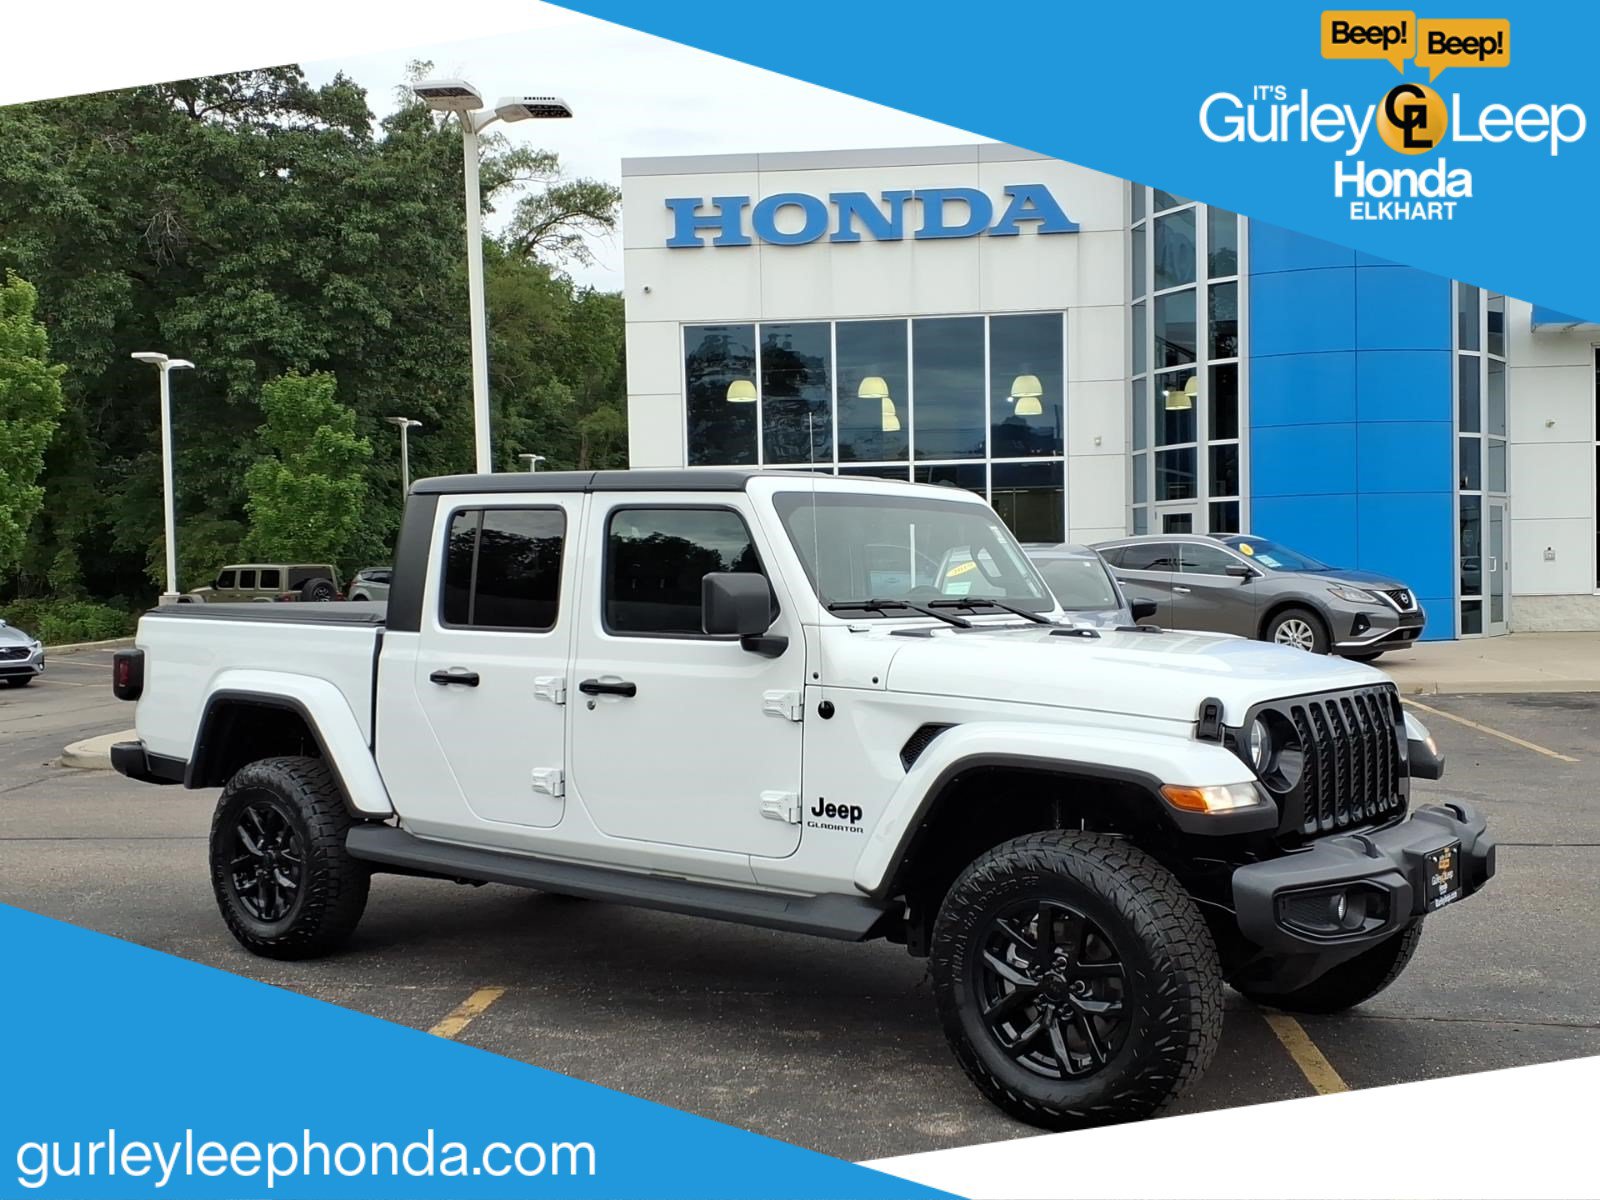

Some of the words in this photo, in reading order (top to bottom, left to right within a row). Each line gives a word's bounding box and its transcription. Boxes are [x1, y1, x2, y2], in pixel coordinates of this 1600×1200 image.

[665, 183, 1080, 249] HONDA
[811, 797, 863, 824] Jeep
[807, 821, 864, 834] GLADIATOR
